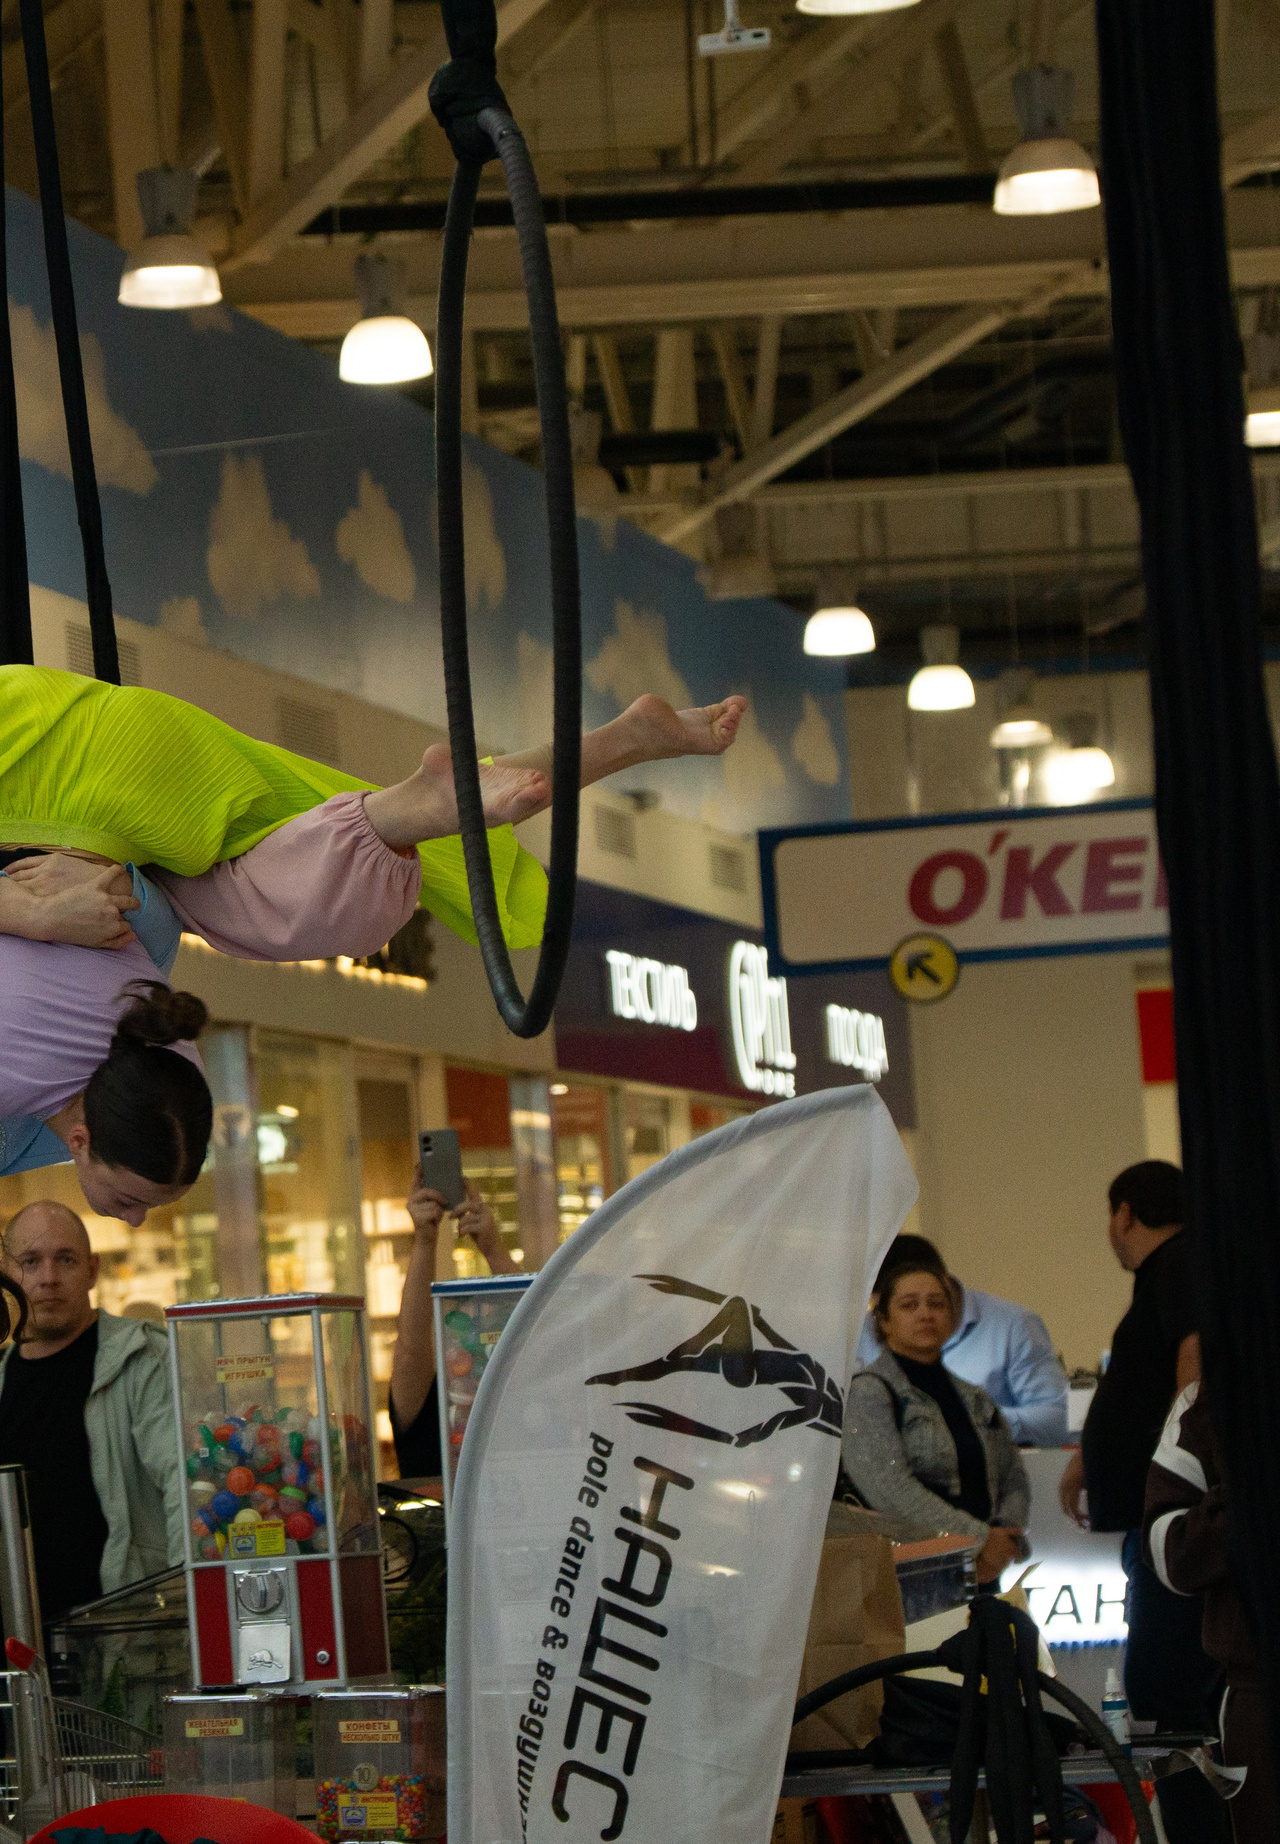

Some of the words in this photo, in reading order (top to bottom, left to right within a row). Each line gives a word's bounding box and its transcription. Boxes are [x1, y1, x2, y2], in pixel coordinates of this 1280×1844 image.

[578, 1431, 615, 1509] pole
[550, 1515, 594, 1618] dance
[541, 1625, 570, 1651] &
[346, 1722, 391, 1731] КОНФЕТЫ
